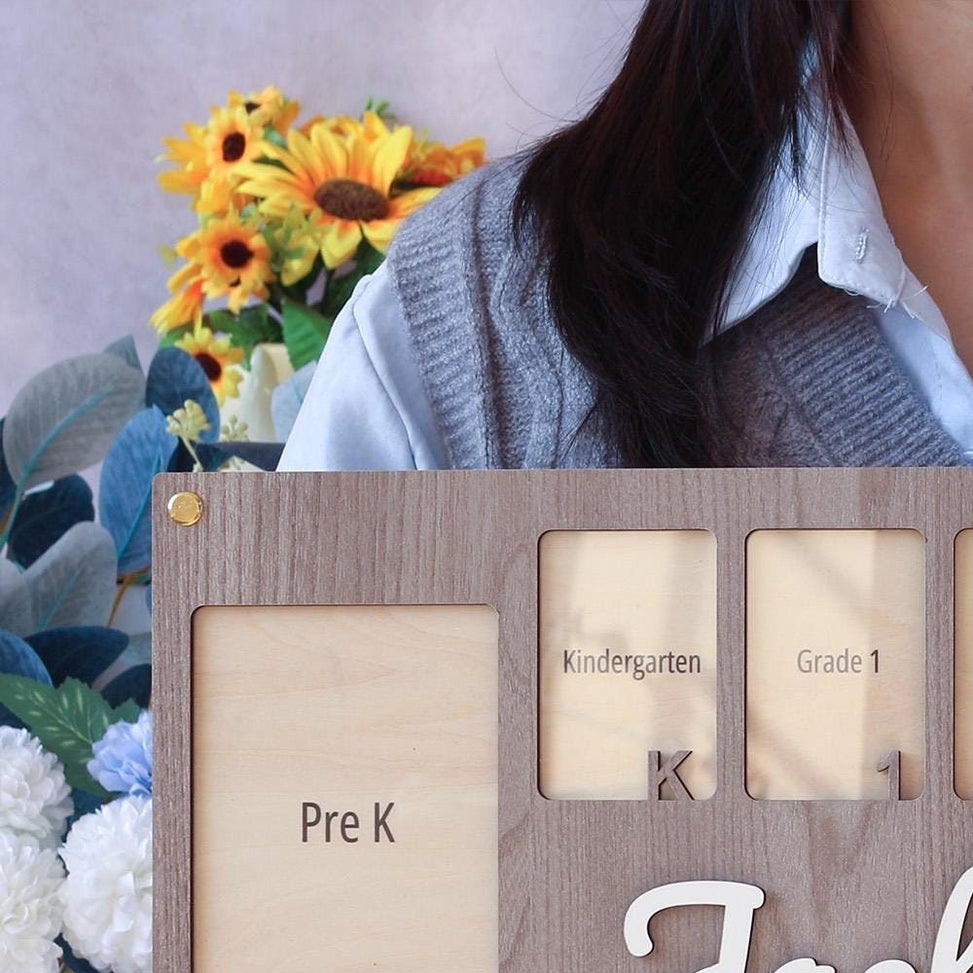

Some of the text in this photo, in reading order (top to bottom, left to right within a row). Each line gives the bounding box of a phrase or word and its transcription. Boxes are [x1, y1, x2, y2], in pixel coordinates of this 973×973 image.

[562, 649, 701, 680] Kindergarten
[797, 649, 880, 674] Grade 1
[647, 749, 693, 801] K
[877, 750, 901, 801] 1
[300, 802, 395, 843] Pre K
